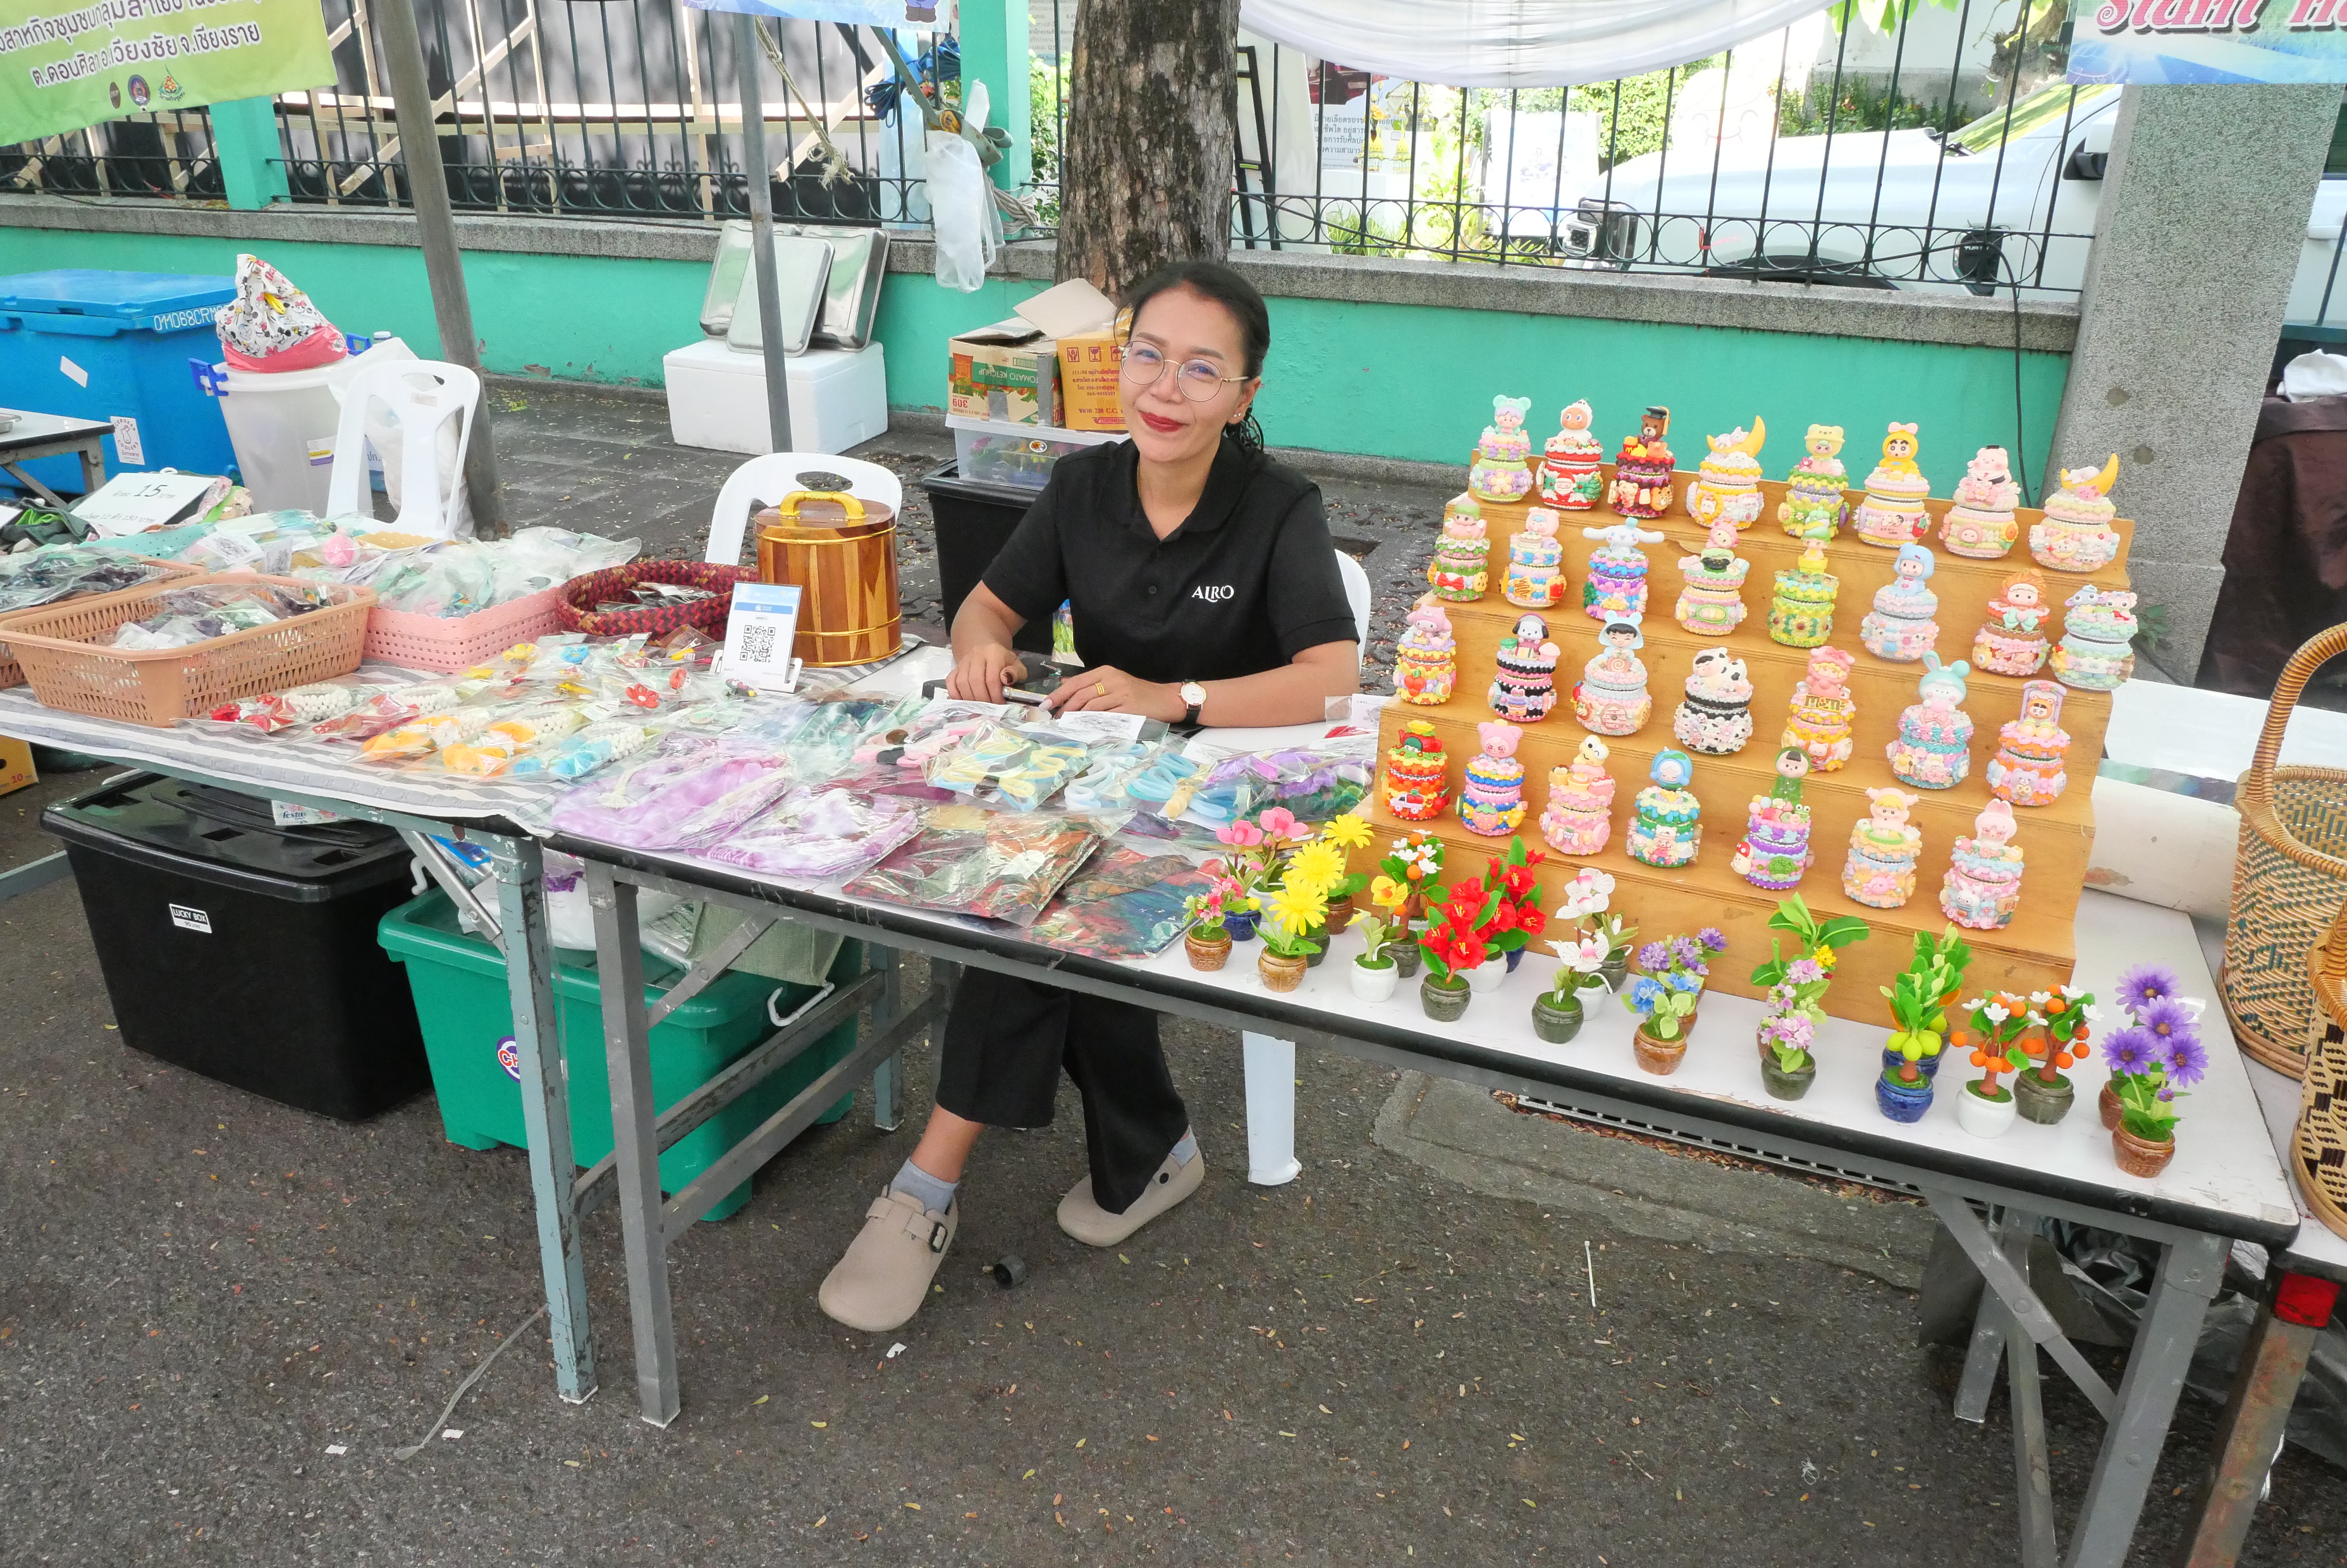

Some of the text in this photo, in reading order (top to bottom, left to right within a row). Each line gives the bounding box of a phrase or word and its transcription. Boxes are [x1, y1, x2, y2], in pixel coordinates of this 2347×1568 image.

[180, 24, 260, 54] จ.เชียงราย
[979, 368, 1038, 384] TOMATO KETCHUP
[953, 398, 968, 408] 309
[133, 484, 168, 498] 15
[1191, 585, 1235, 603] ALRO
[283, 811, 303, 819] festa
[173, 908, 207, 922] LUCKY BOX
